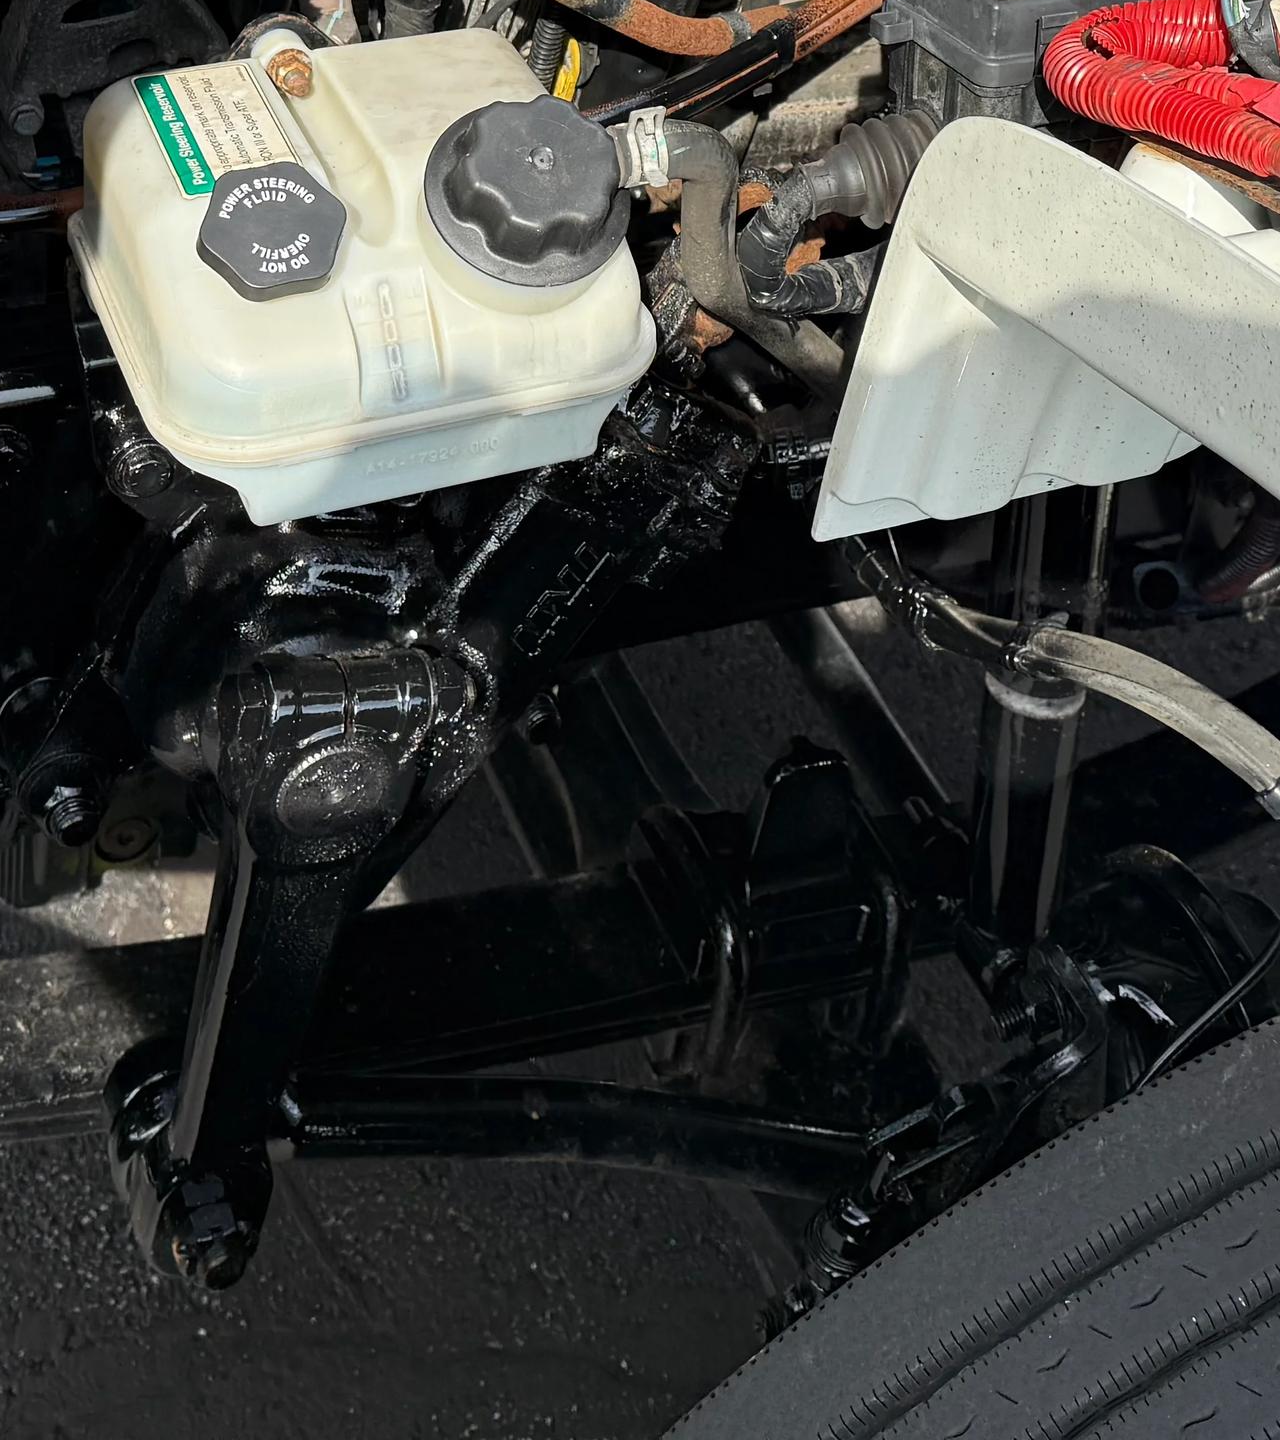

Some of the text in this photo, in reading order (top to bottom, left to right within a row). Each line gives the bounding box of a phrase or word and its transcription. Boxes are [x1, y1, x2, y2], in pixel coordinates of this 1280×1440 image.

[191, 101, 202, 112] on
[207, 91, 235, 133] Transmission
[196, 110, 211, 129] mark
[240, 110, 260, 133] Super
[150, 82, 209, 186] Power Steering Reservoir
[228, 132, 253, 165] Automatic
[218, 177, 315, 219] POWER STEERING
[242, 190, 286, 208] FLUID
[251, 233, 310, 259] OVERFILL
[259, 253, 309, 273] DO NOT
